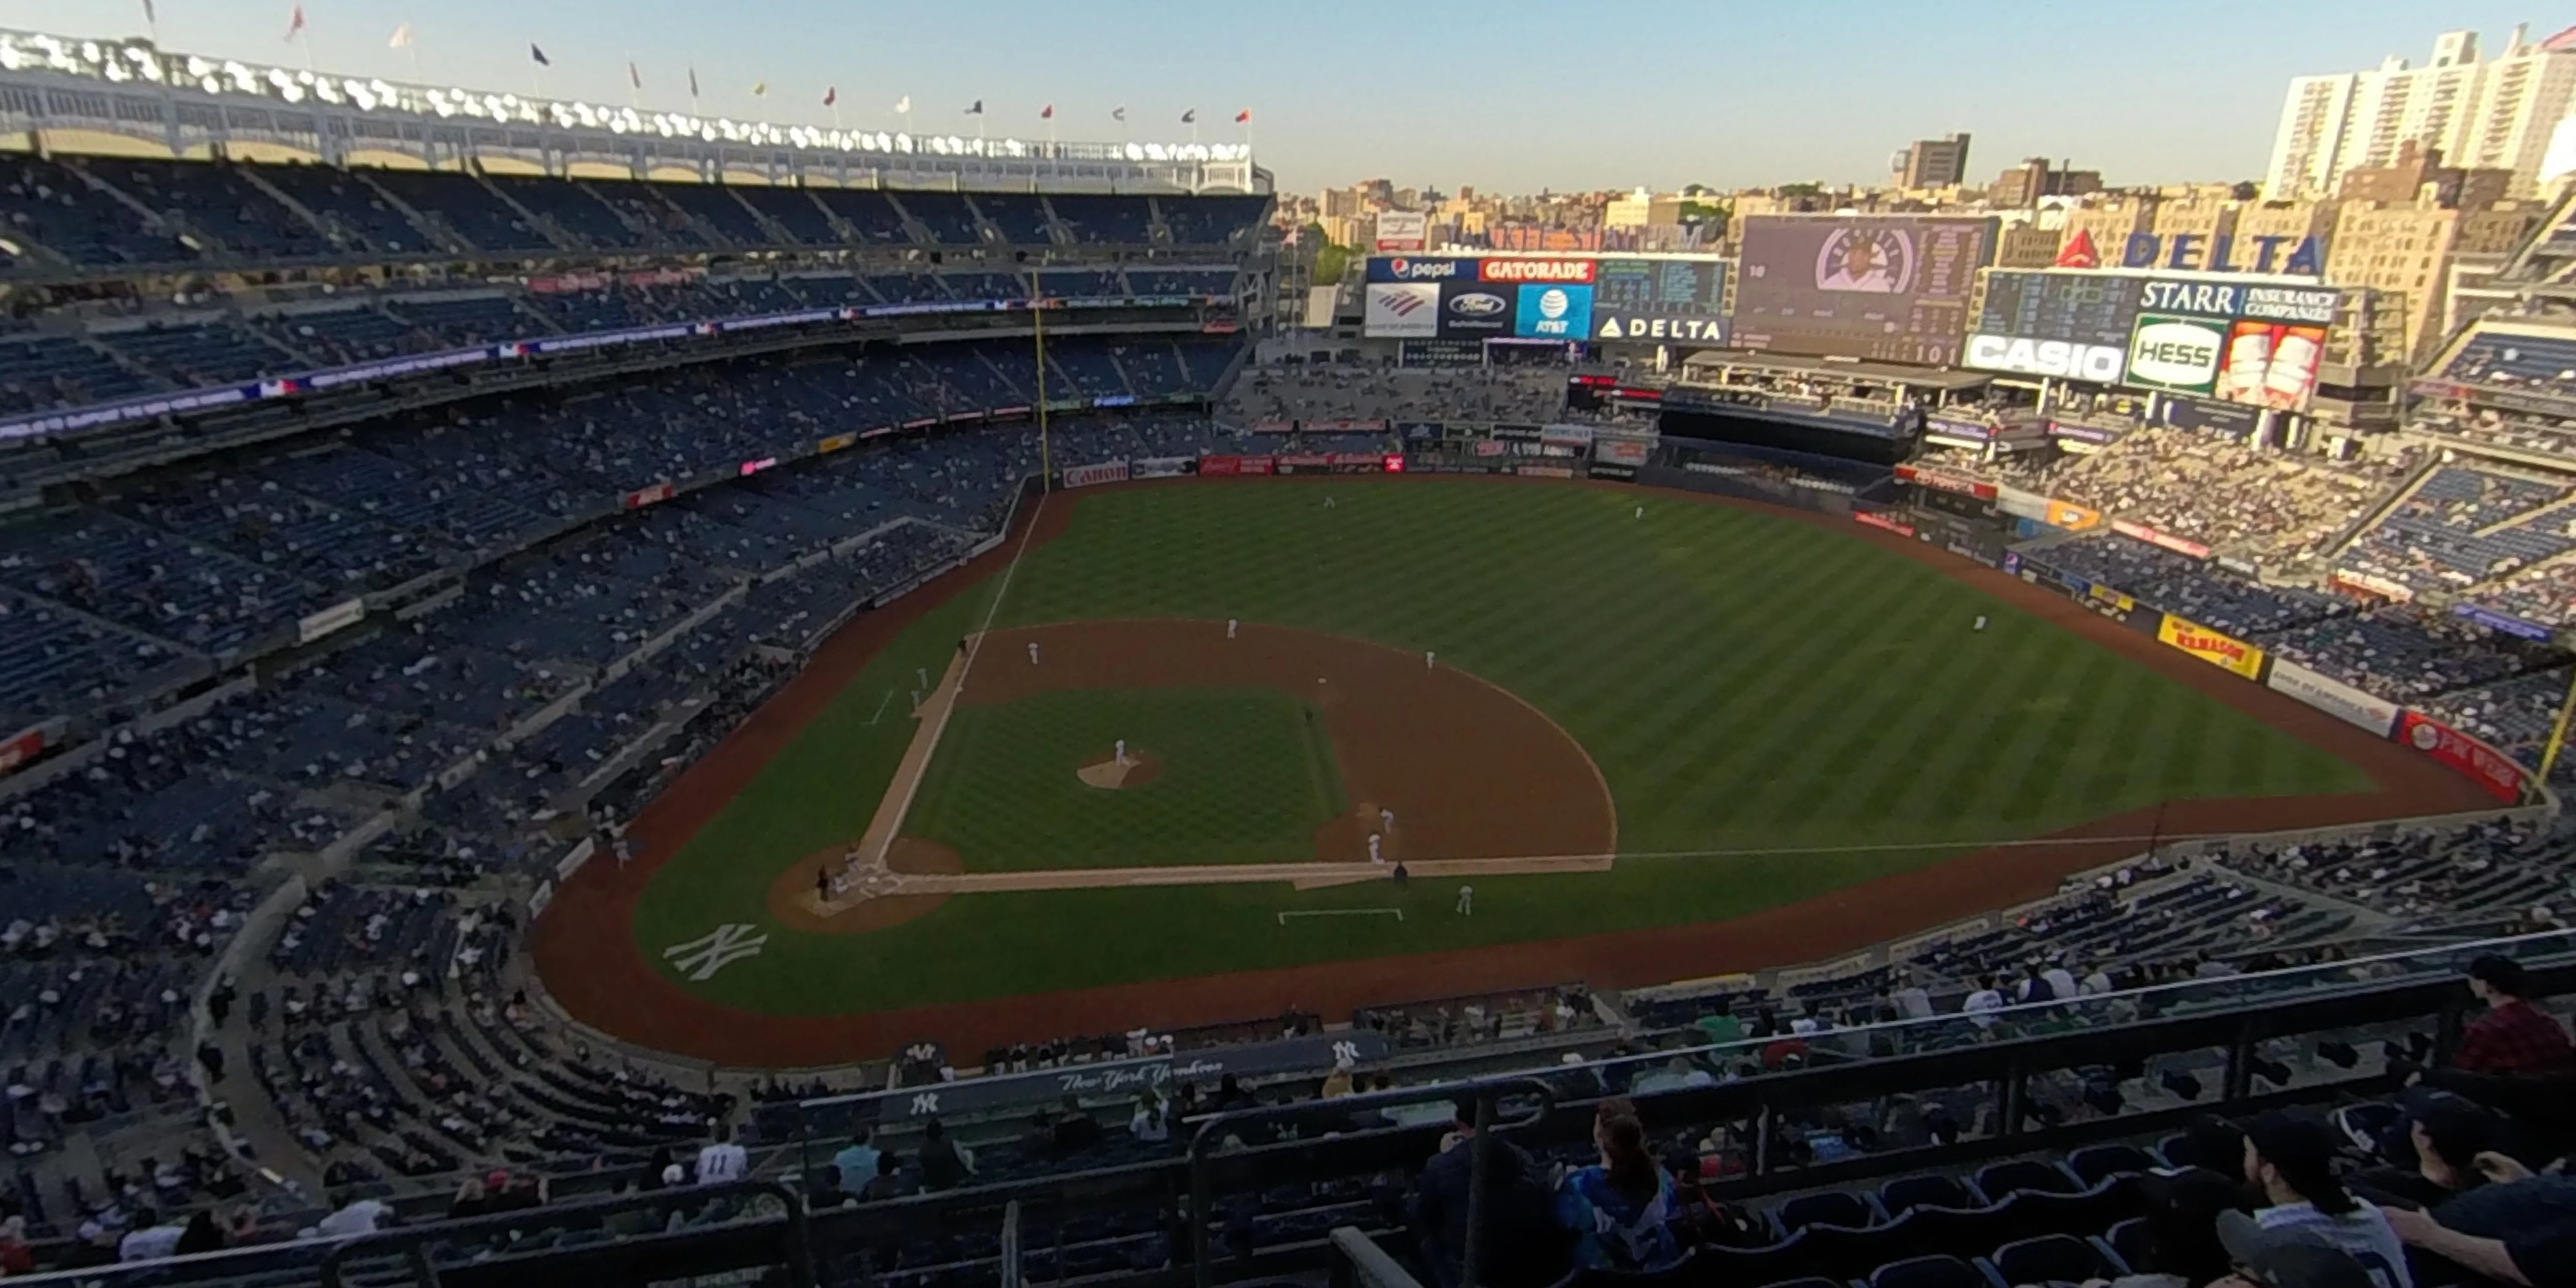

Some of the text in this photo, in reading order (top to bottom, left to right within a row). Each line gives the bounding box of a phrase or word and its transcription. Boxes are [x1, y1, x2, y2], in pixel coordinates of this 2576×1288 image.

[2123, 233, 2327, 275] DELTA
[1412, 260, 1455, 279] pepsi
[1486, 261, 1588, 280] GATORADE
[2140, 282, 2235, 314] STARR
[1535, 321, 1569, 334] AT&T
[1629, 318, 1721, 341] DELTA
[1969, 334, 2122, 382] CASIO
[2138, 340, 2212, 367] HESS
[1066, 466, 1127, 485] Canon
[663, 923, 769, 981] NY
[707, 1153, 728, 1175] 11
